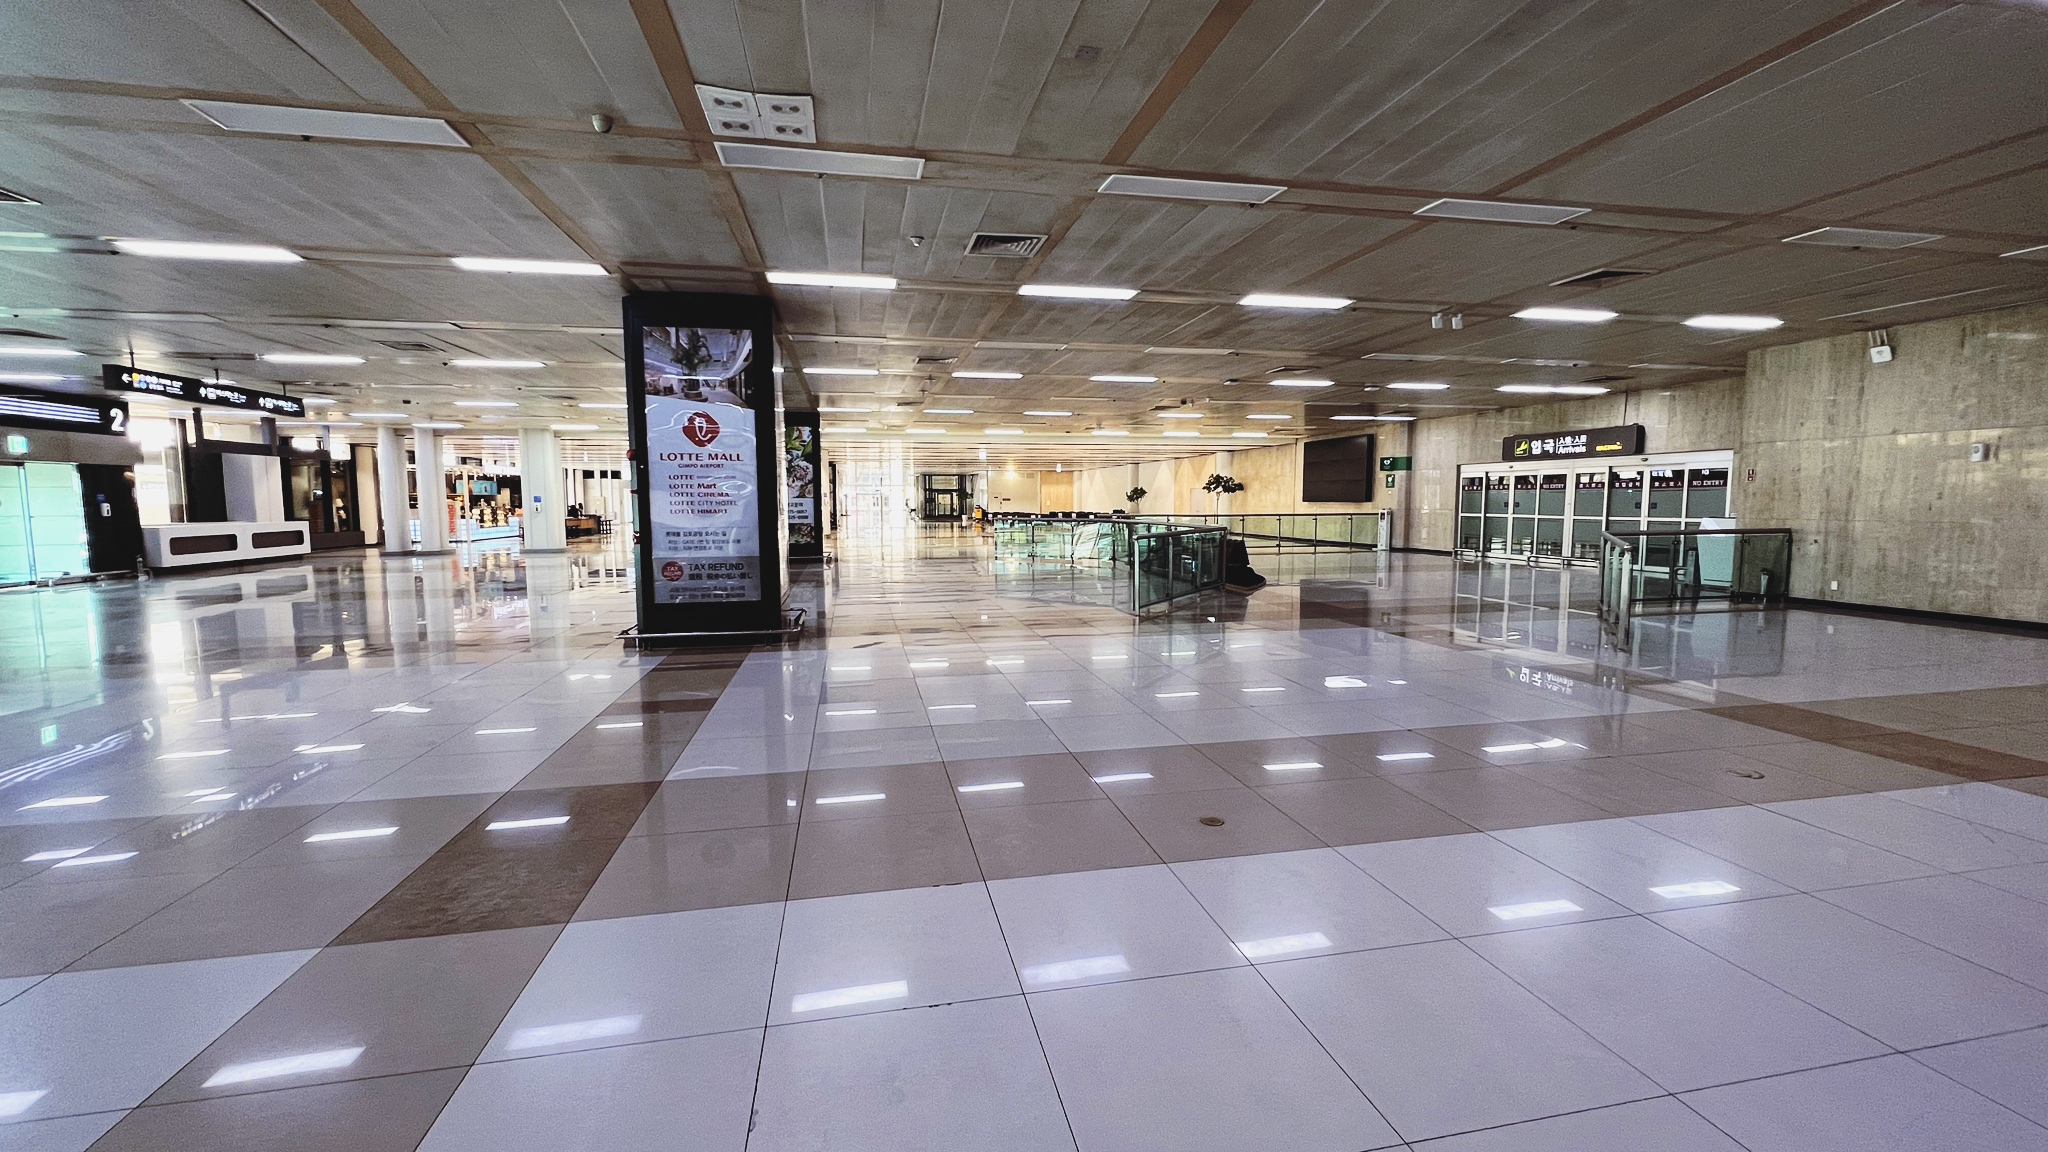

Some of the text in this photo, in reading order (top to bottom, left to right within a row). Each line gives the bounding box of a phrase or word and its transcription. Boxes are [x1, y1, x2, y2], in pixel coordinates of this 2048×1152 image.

[109, 407, 125, 432] 2
[1530, 438, 1556, 455] 입국
[1557, 444, 1587, 455] Arrivals
[659, 452, 744, 462] LOTTE MALL
[697, 482, 717, 490] Mart
[687, 562, 745, 572] TAX REFUND
